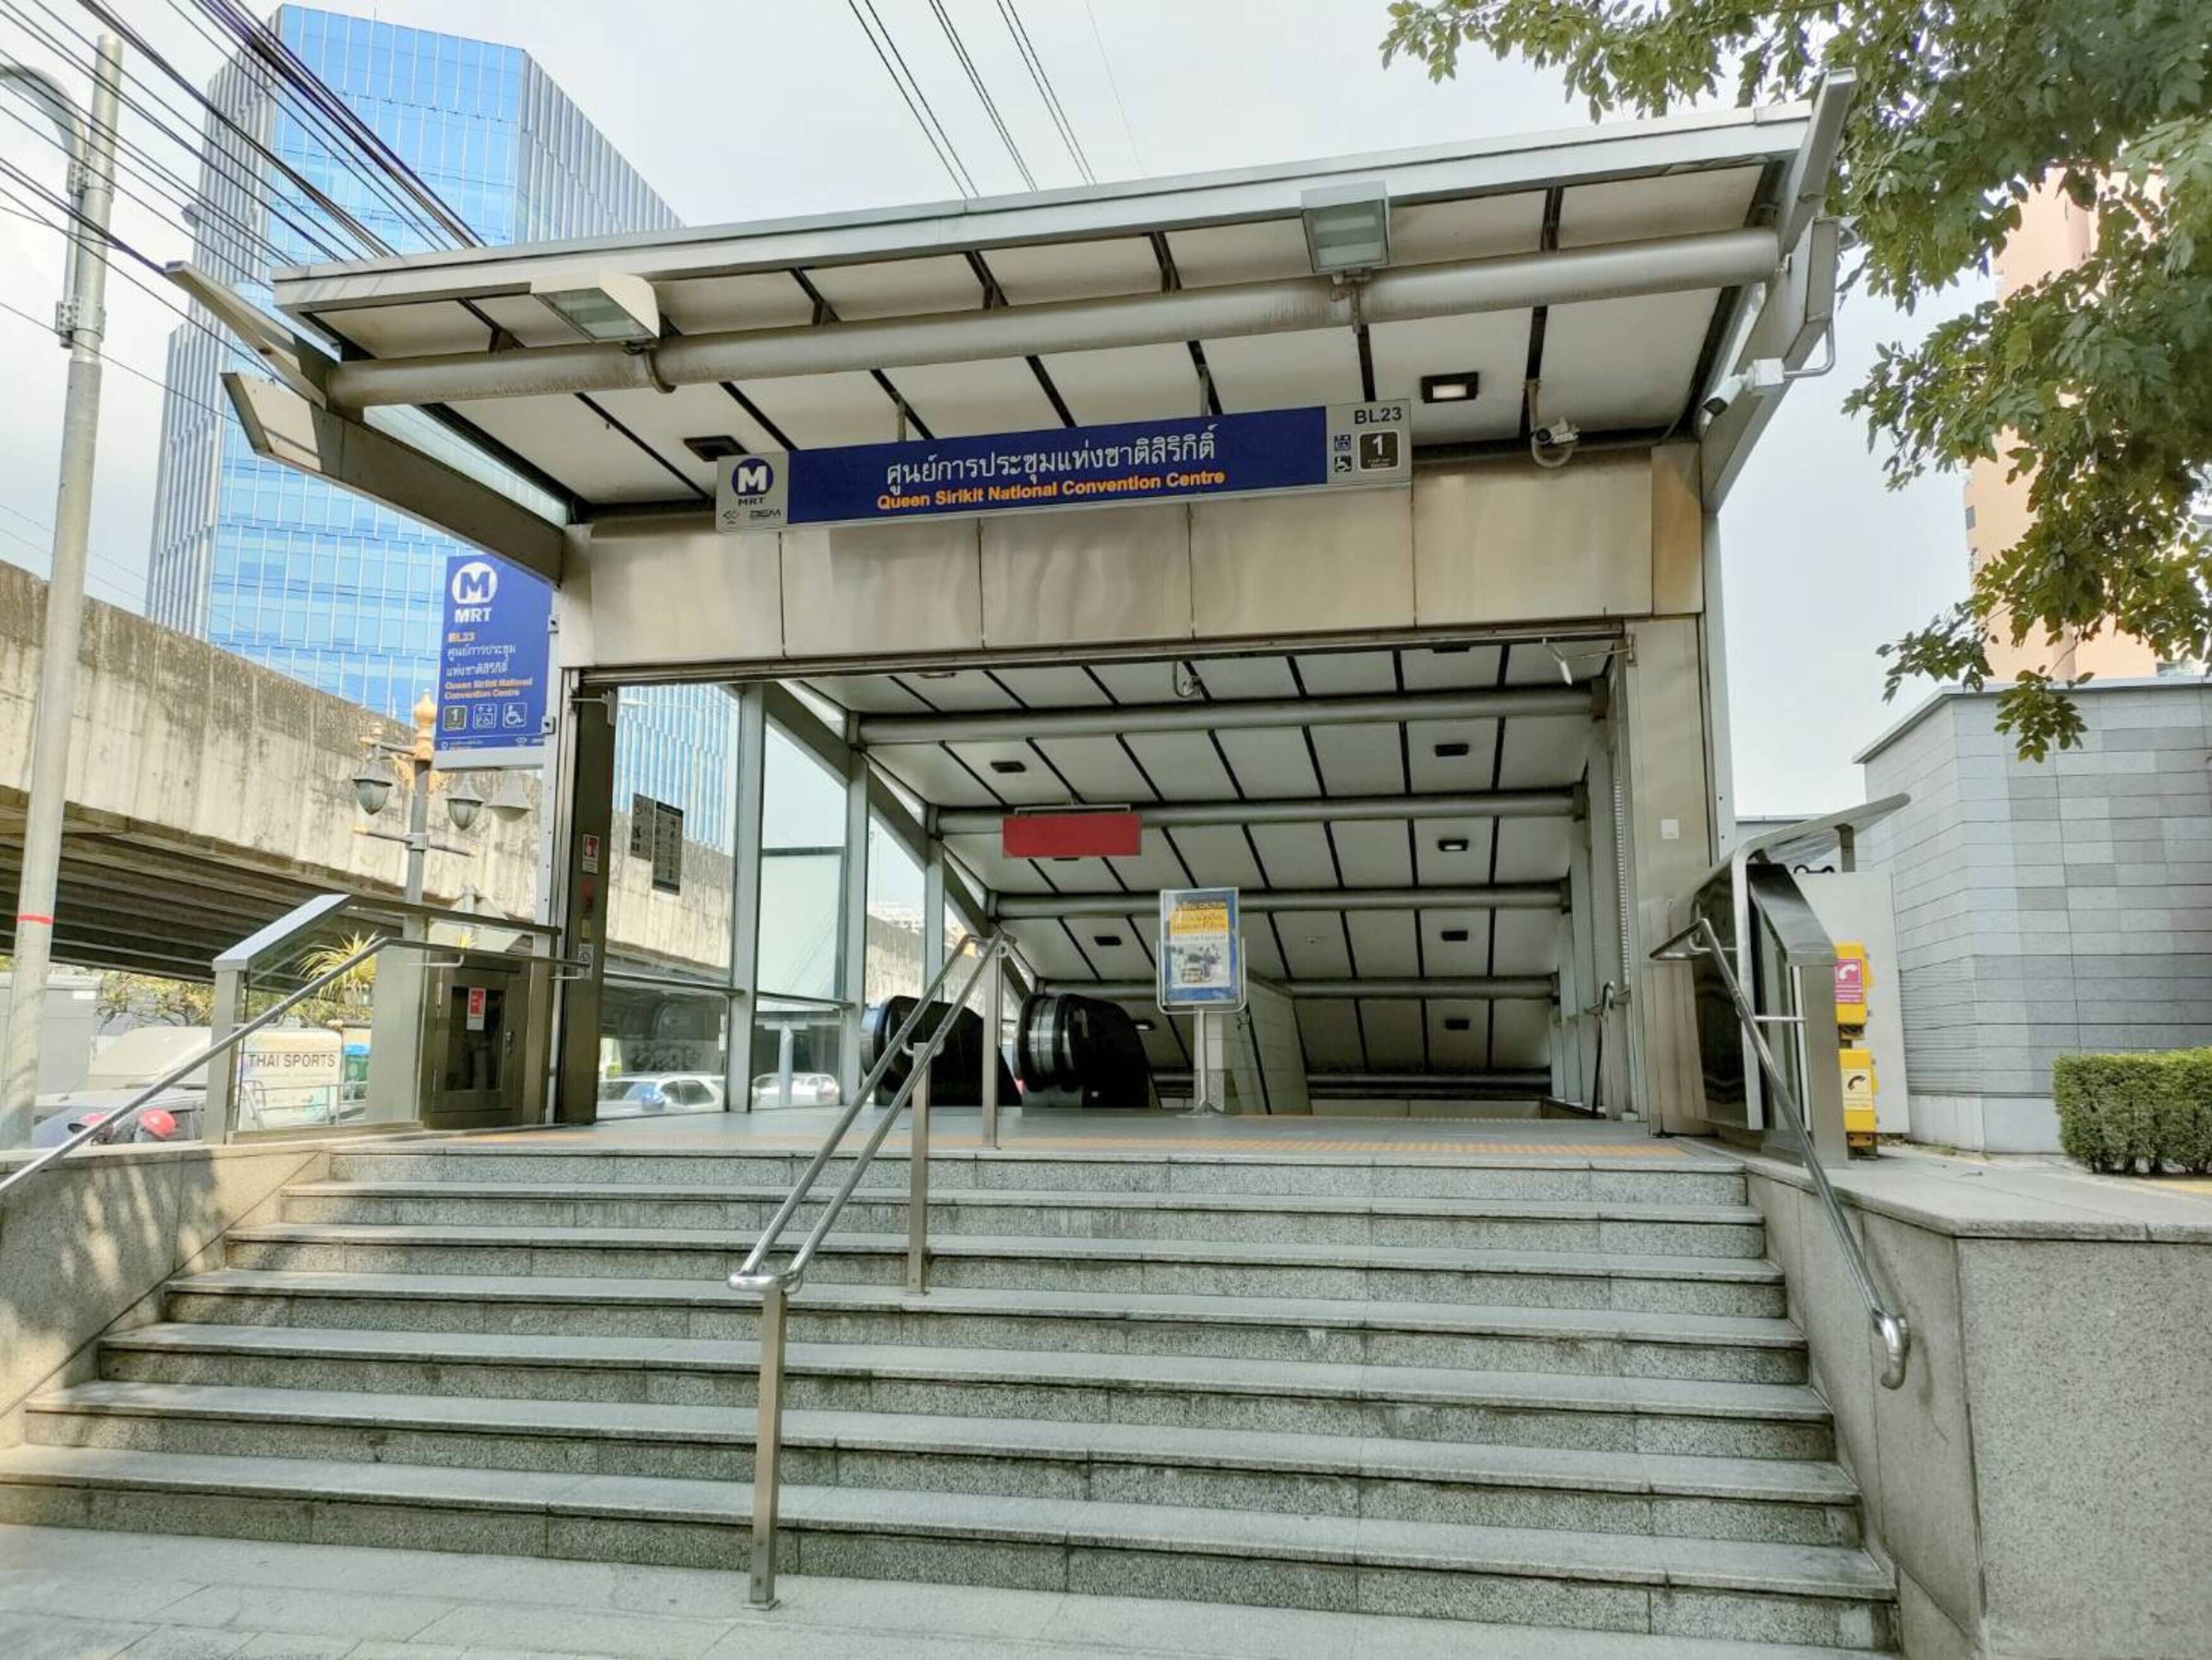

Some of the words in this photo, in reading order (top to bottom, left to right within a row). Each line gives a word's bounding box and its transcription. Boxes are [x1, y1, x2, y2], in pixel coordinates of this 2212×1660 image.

[1354, 406, 1402, 425] BL23
[1371, 434, 1383, 456] 1
[887, 424, 1218, 495] ศูนย์การประชุมแห่งชาติสิริกิติ์
[877, 494, 930, 510] Queen
[935, 487, 983, 505] Sirikit
[988, 482, 1057, 501] National
[1062, 476, 1160, 496] Convention
[1166, 470, 1225, 487] Centre
[738, 497, 765, 506] MRT
[454, 607, 492, 623] MRT
[249, 1054, 278, 1067] THAI
[284, 1054, 335, 1067] SPORTS
